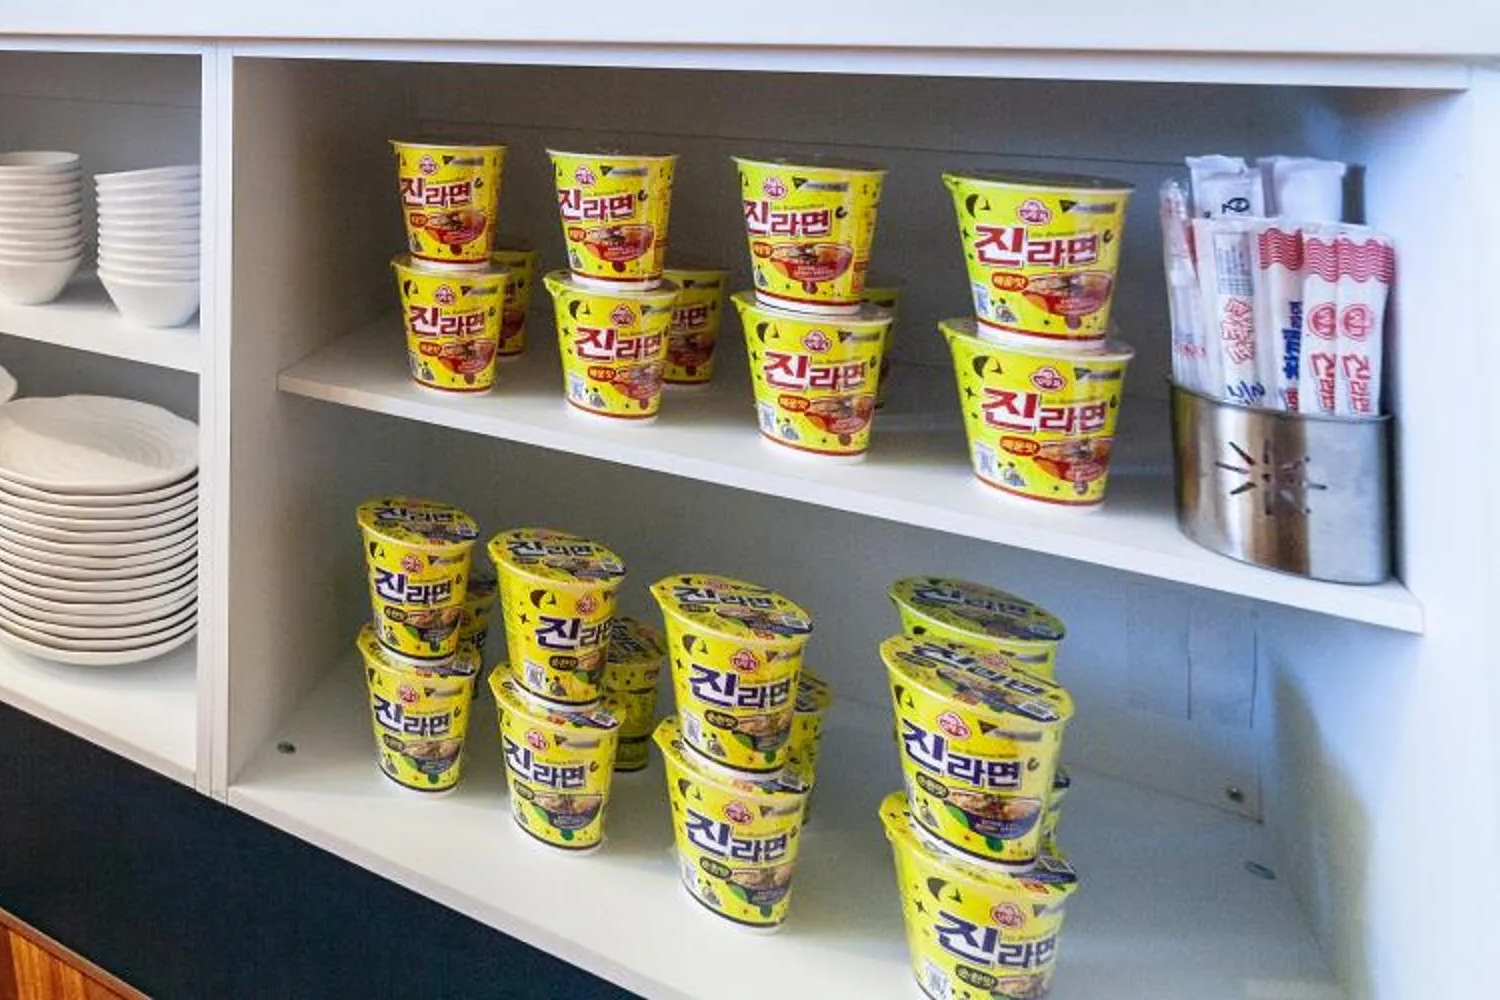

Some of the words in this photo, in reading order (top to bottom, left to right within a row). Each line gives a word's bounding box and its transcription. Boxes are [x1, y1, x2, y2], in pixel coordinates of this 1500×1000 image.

[401, 177, 472, 206] 진라면
[558, 189, 633, 221] 진라면
[743, 201, 831, 236] 진라면
[975, 225, 1097, 267] 진라면
[410, 306, 485, 337] 진라면
[575, 327, 661, 361] 진라면
[764, 352, 866, 391] 진라면
[982, 388, 1107, 432] 진라면
[375, 567, 451, 605] 진라면
[689, 664, 790, 708] 진라면
[374, 694, 450, 736] 진라면
[503, 736, 586, 789] 진라면
[902, 718, 1021, 787] 진라면
[685, 808, 787, 862] 진라면
[934, 910, 1056, 969] 진라면
